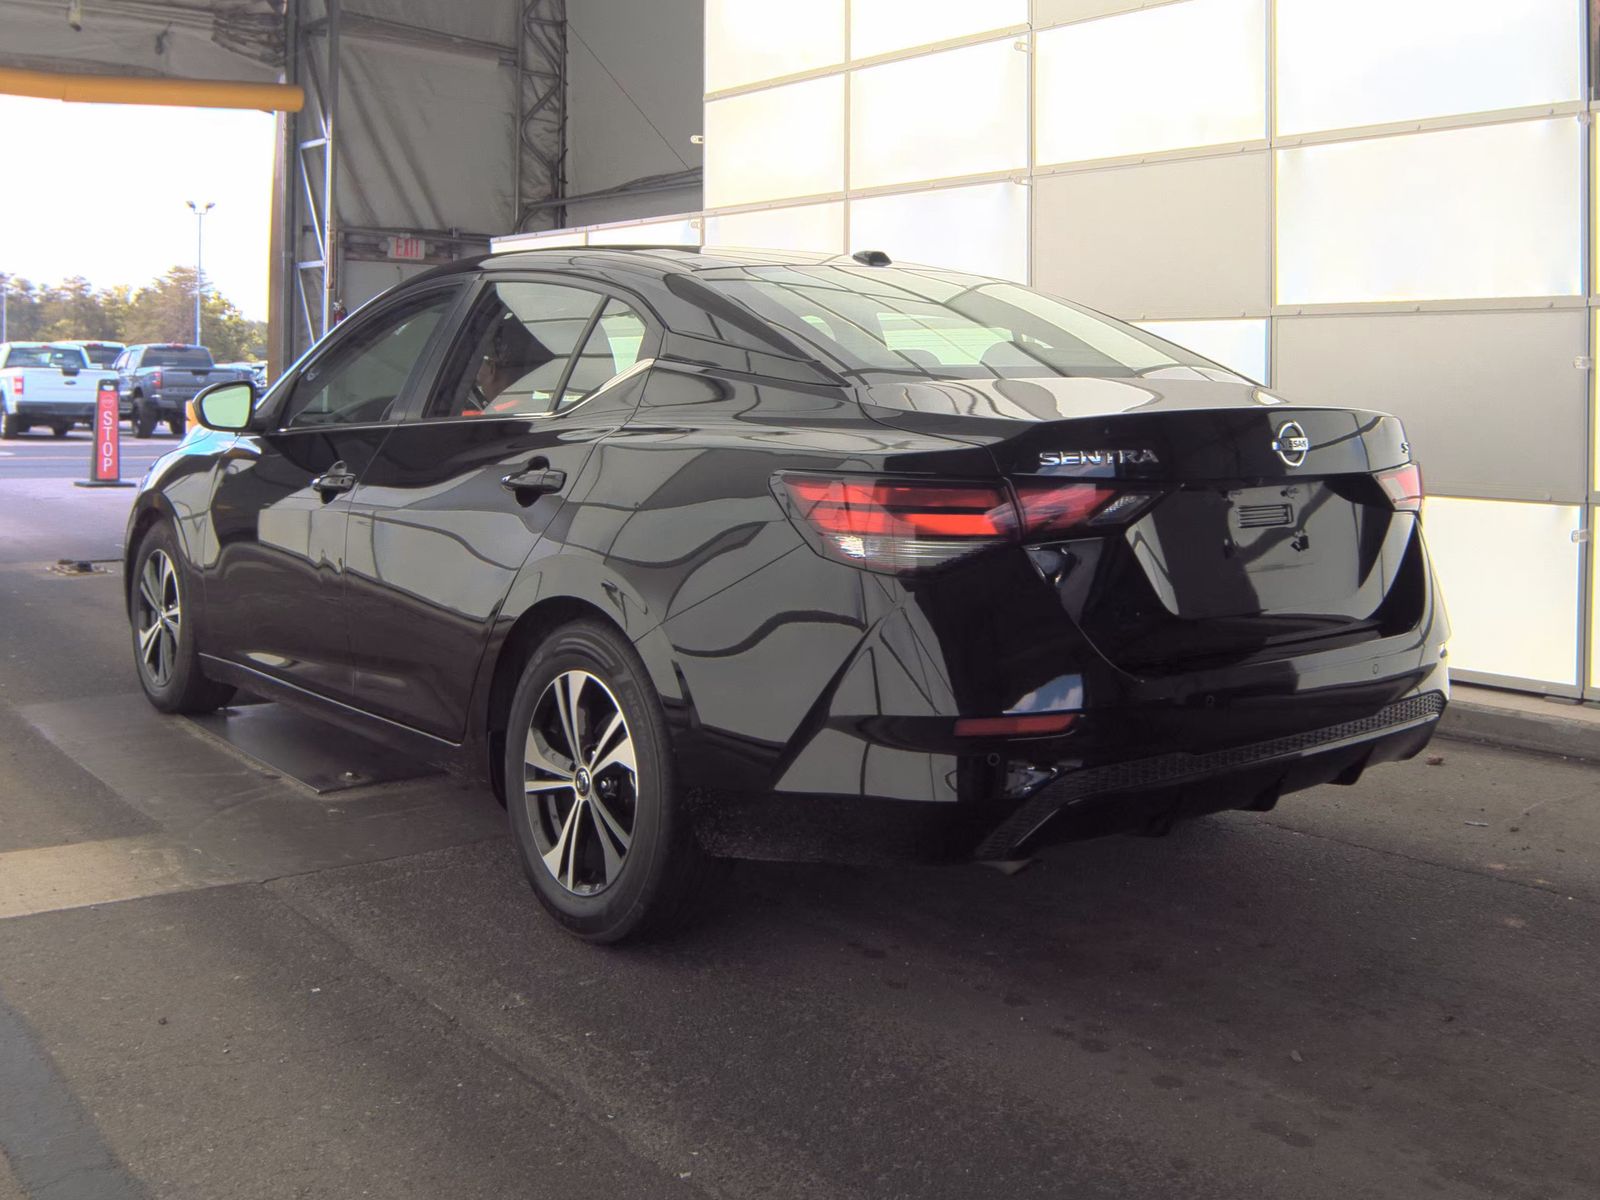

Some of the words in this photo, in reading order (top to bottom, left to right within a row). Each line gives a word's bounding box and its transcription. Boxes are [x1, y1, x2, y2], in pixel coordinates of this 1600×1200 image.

[395, 237, 421, 257] EXIT
[102, 410, 113, 472] STOP
[1039, 449, 1160, 466] SENTRA
